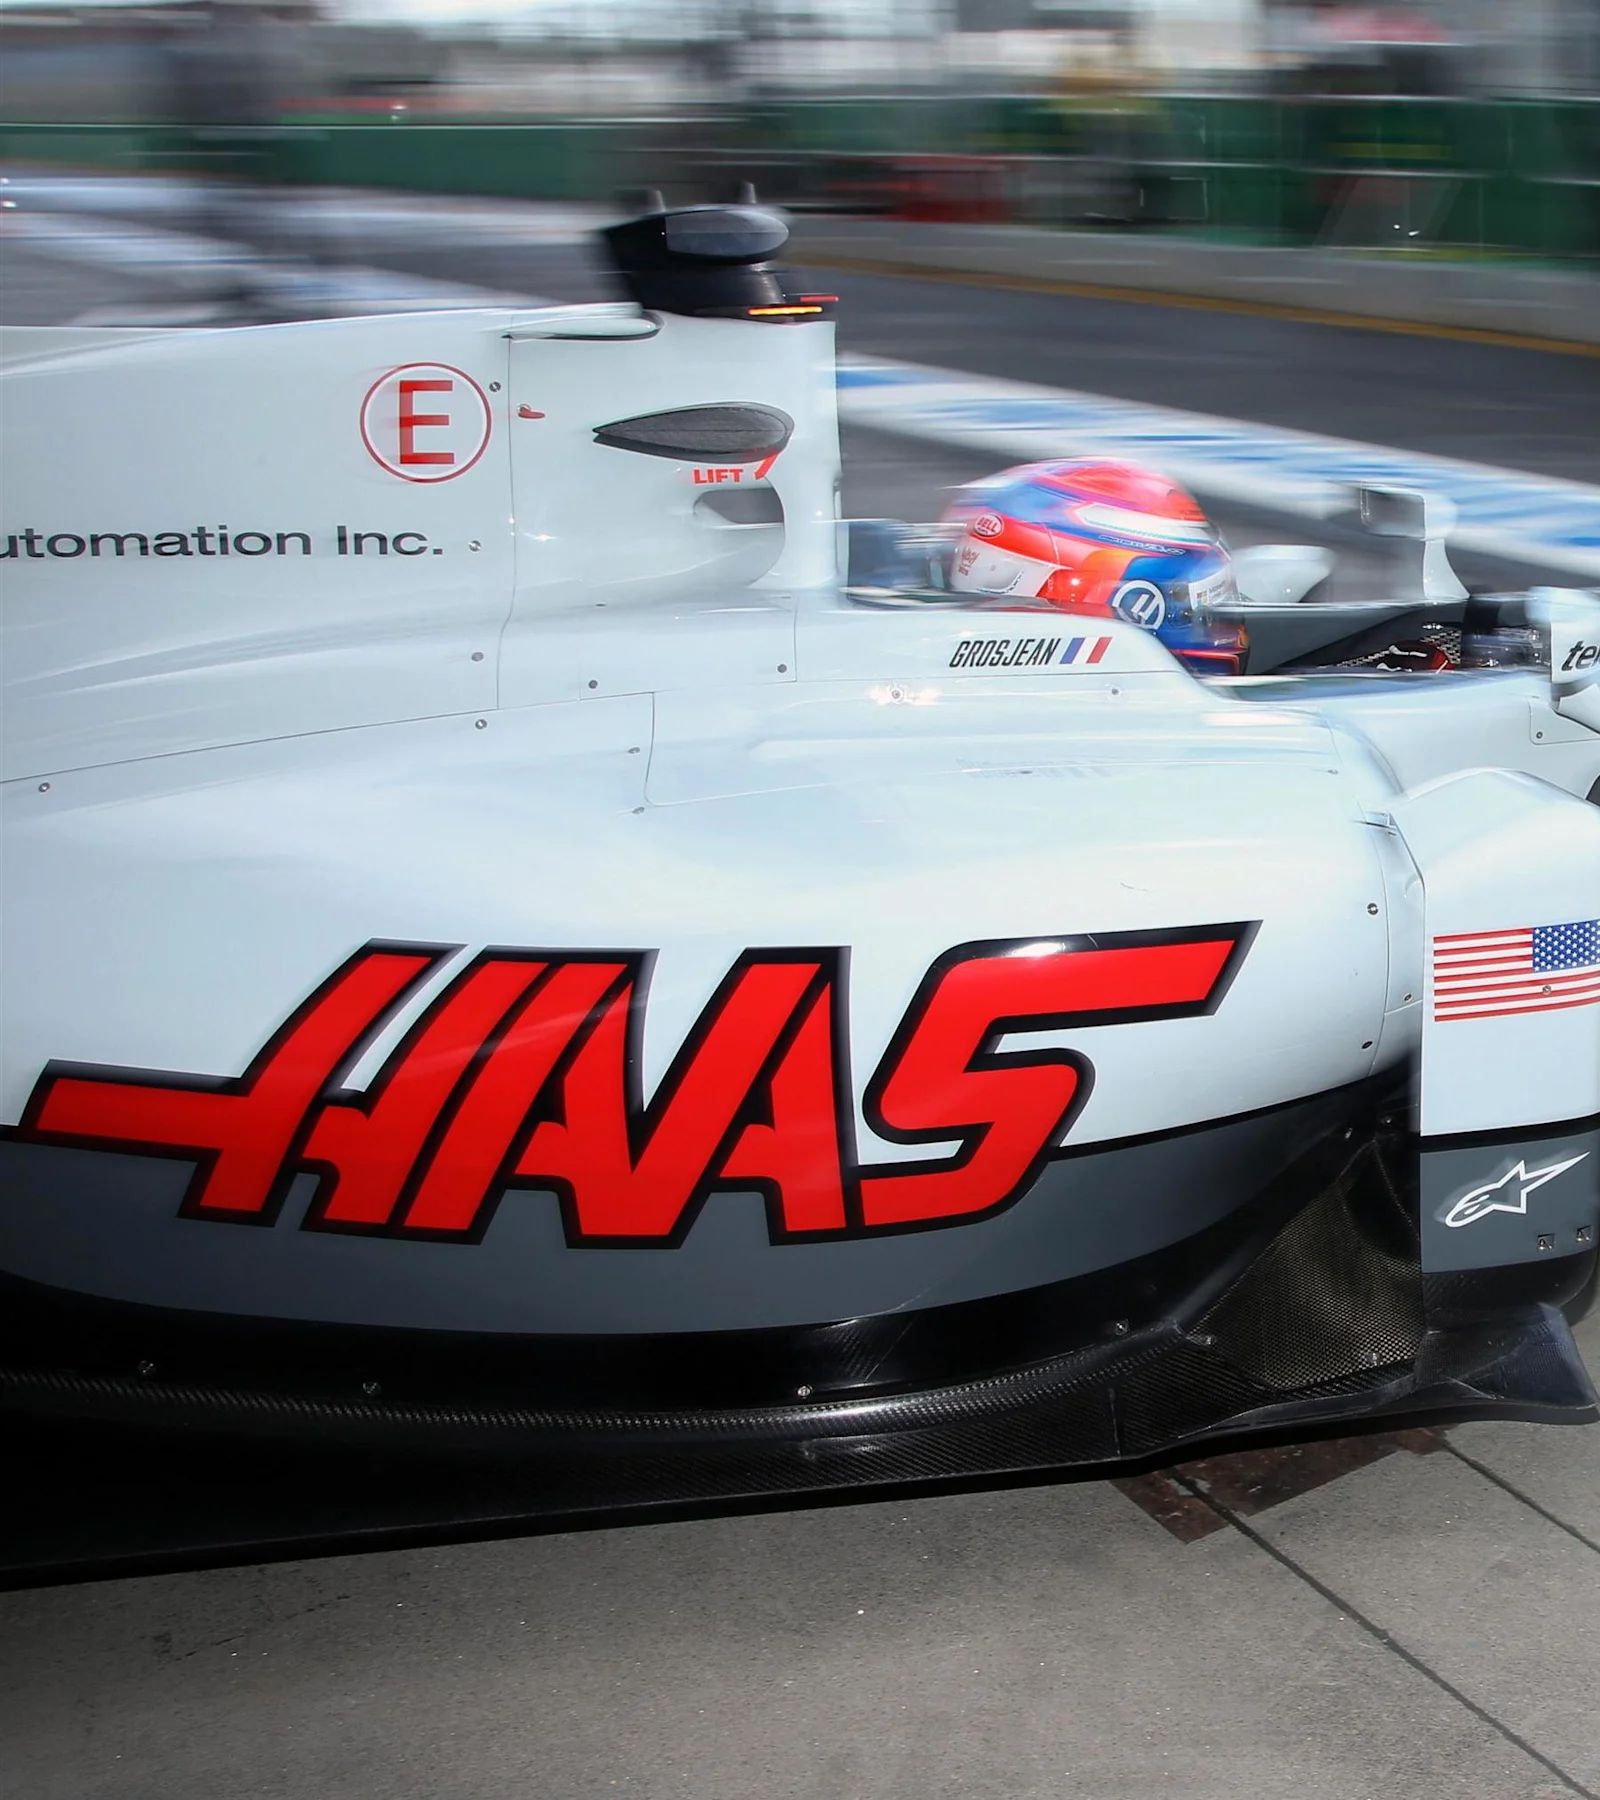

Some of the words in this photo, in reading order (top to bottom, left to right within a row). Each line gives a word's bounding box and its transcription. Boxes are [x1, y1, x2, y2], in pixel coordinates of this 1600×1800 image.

[399, 379, 455, 465] E
[693, 468, 744, 485] LIFT
[336, 525, 443, 556] Inc.
[949, 637, 1062, 668] GROSJEAN
[18, 918, 1263, 1249] HAAS
